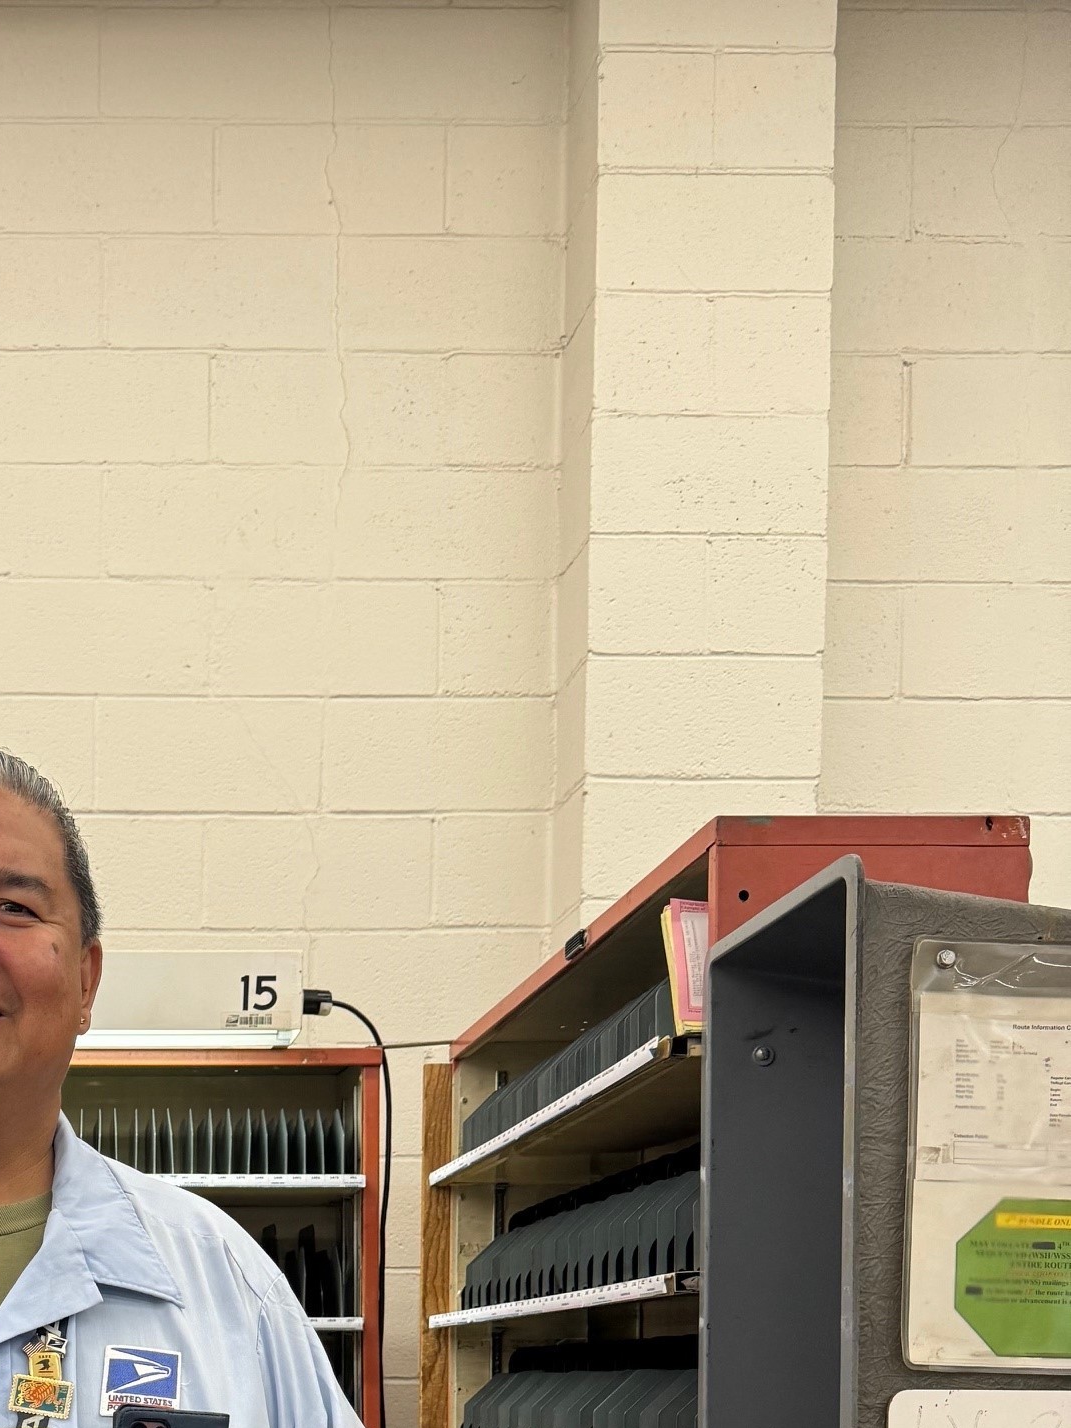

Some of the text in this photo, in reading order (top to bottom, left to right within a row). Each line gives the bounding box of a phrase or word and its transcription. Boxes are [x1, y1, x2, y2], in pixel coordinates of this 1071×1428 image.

[240, 975, 277, 1011] 15
[108, 1394, 173, 1407] UNITED STATES
